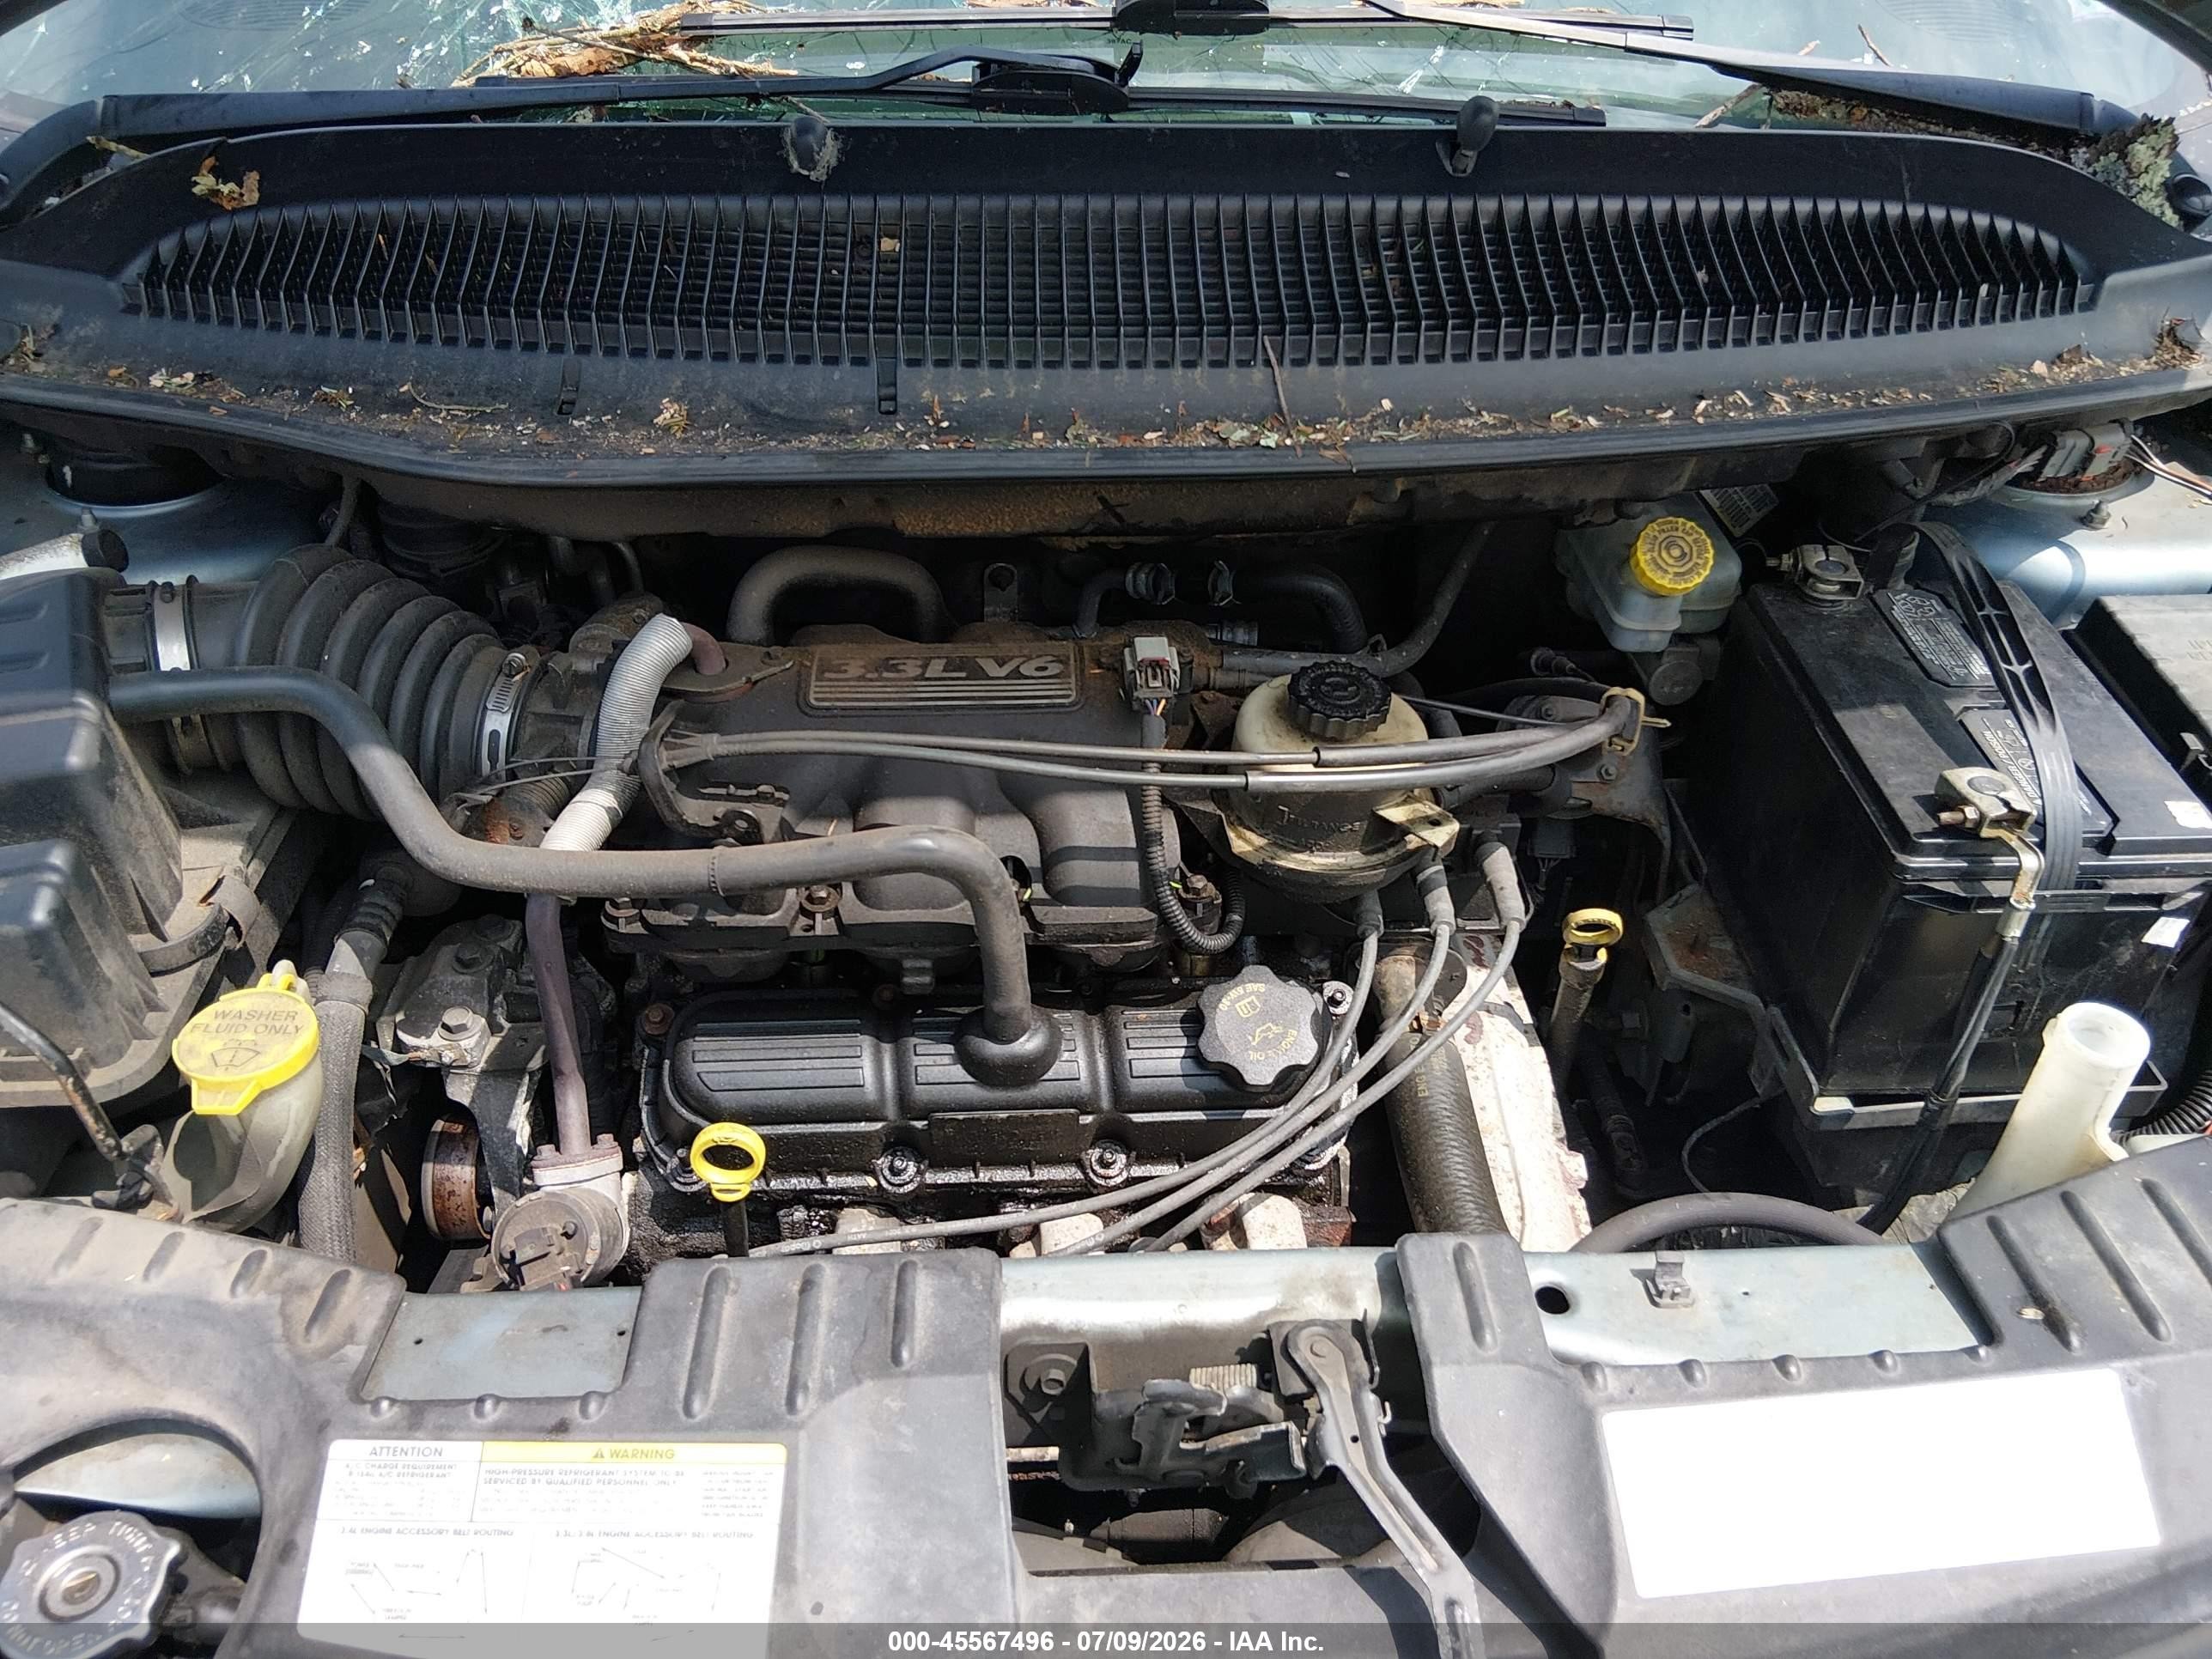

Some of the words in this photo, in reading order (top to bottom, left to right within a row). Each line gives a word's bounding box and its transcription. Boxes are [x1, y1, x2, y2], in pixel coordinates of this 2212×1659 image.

[823, 659, 967, 678] 3.3L
[975, 655, 1064, 678] V6
[213, 1009, 299, 1021] WASHER
[191, 1023, 248, 1034] FLUID
[253, 1023, 304, 1036] ONLY
[1248, 1050, 1266, 1060] OIL
[369, 1446, 444, 1457] ATTENTION
[609, 1448, 676, 1460] WARNING
